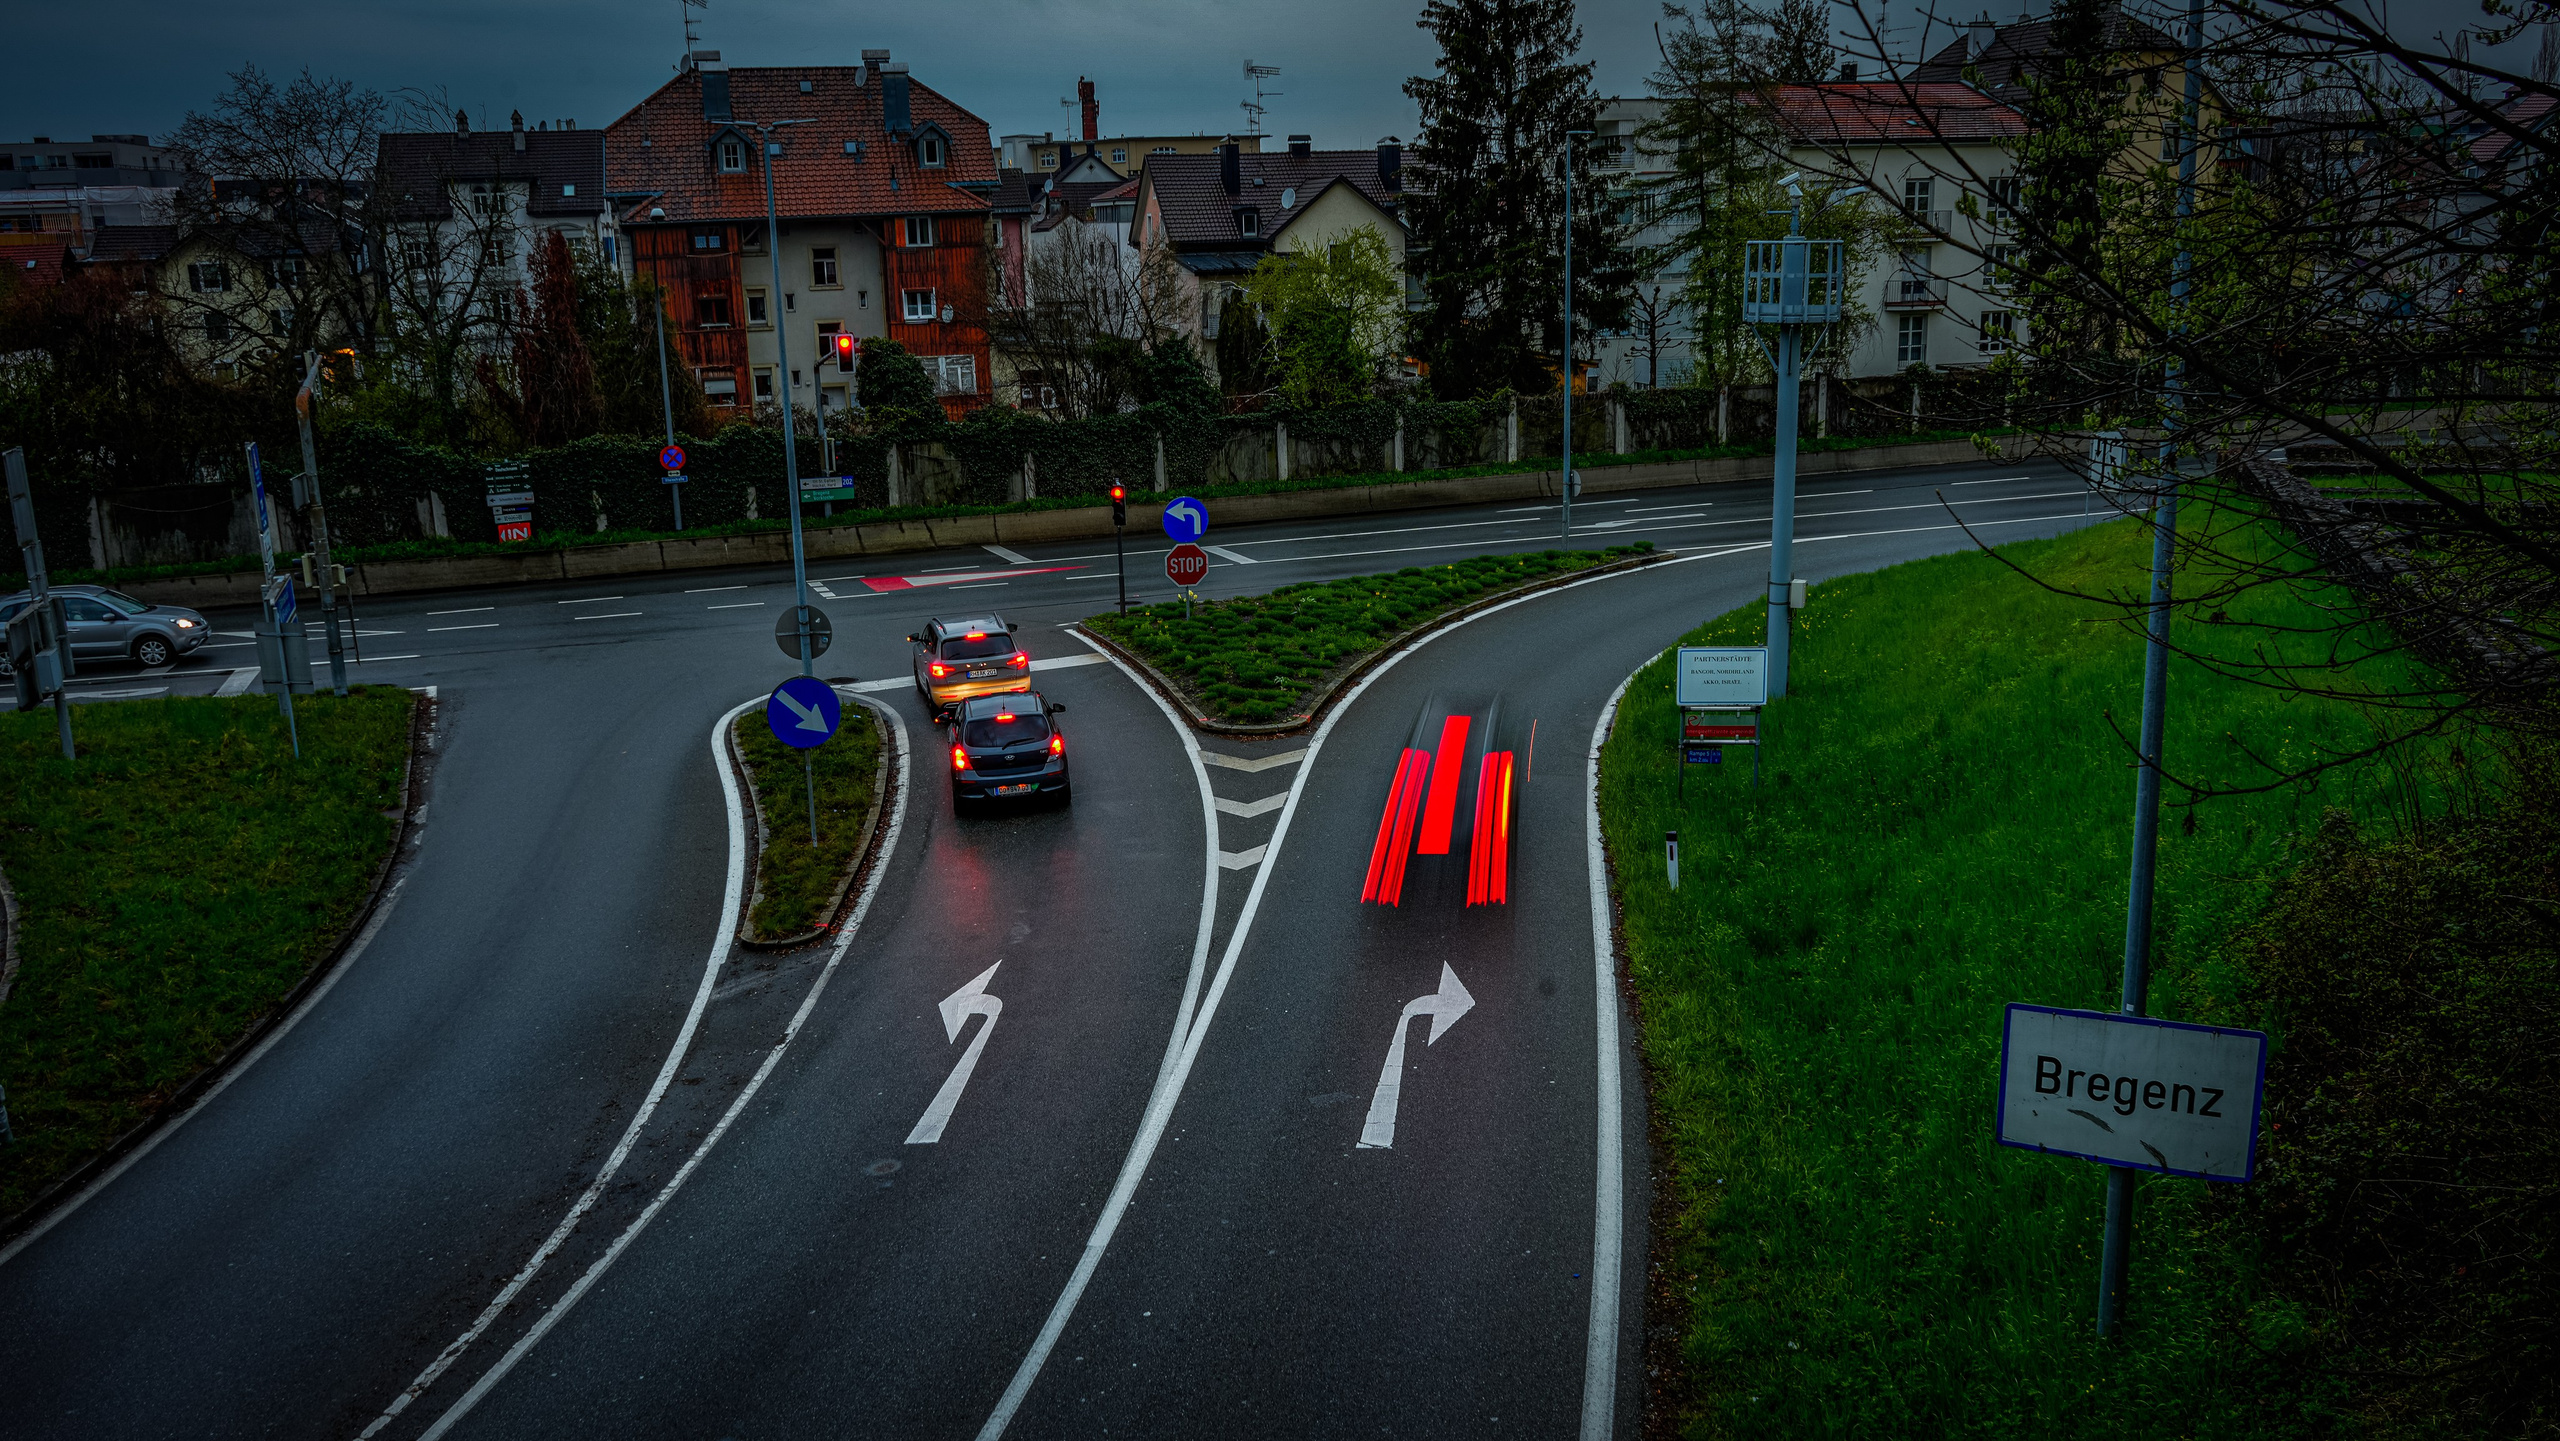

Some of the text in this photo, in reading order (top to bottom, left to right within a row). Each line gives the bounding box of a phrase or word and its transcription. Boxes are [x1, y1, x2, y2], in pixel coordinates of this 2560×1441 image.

[842, 478, 853, 486] 202
[1170, 557, 1204, 574] STOP
[2035, 1055, 2224, 1118] Bregenz
